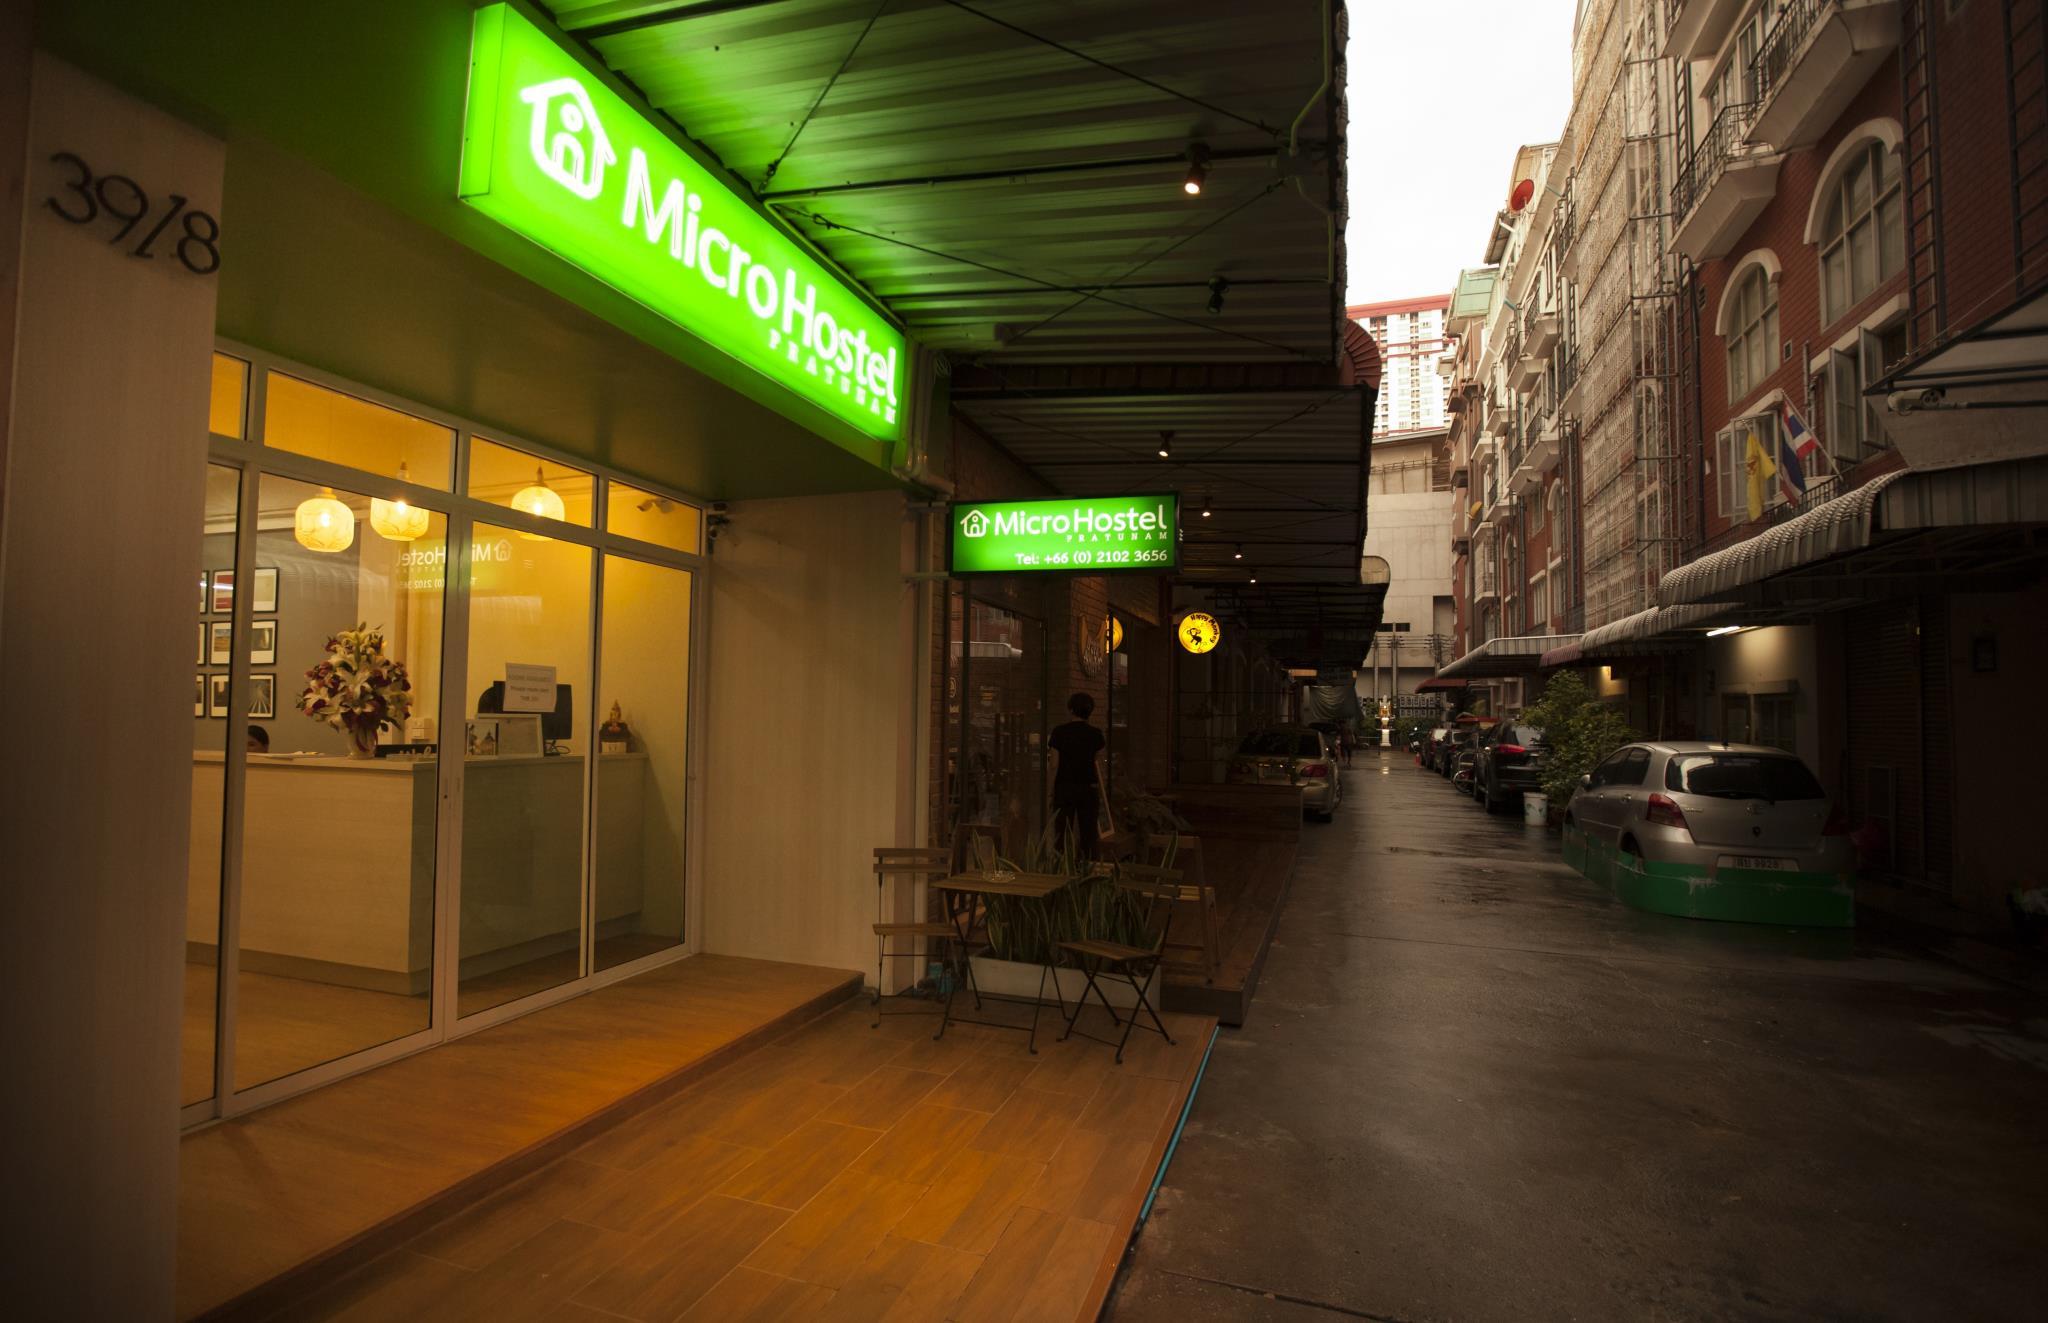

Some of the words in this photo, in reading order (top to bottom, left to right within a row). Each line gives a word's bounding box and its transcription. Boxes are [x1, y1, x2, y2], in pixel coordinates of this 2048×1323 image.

[1066, 531, 1168, 542] PRATUNAM
[1016, 552, 1040, 565] Tel:
[1043, 551, 1069, 564] +66
[1073, 551, 1091, 564] (0)
[1096, 550, 1130, 563] 2102
[1134, 549, 1168, 562] 3656
